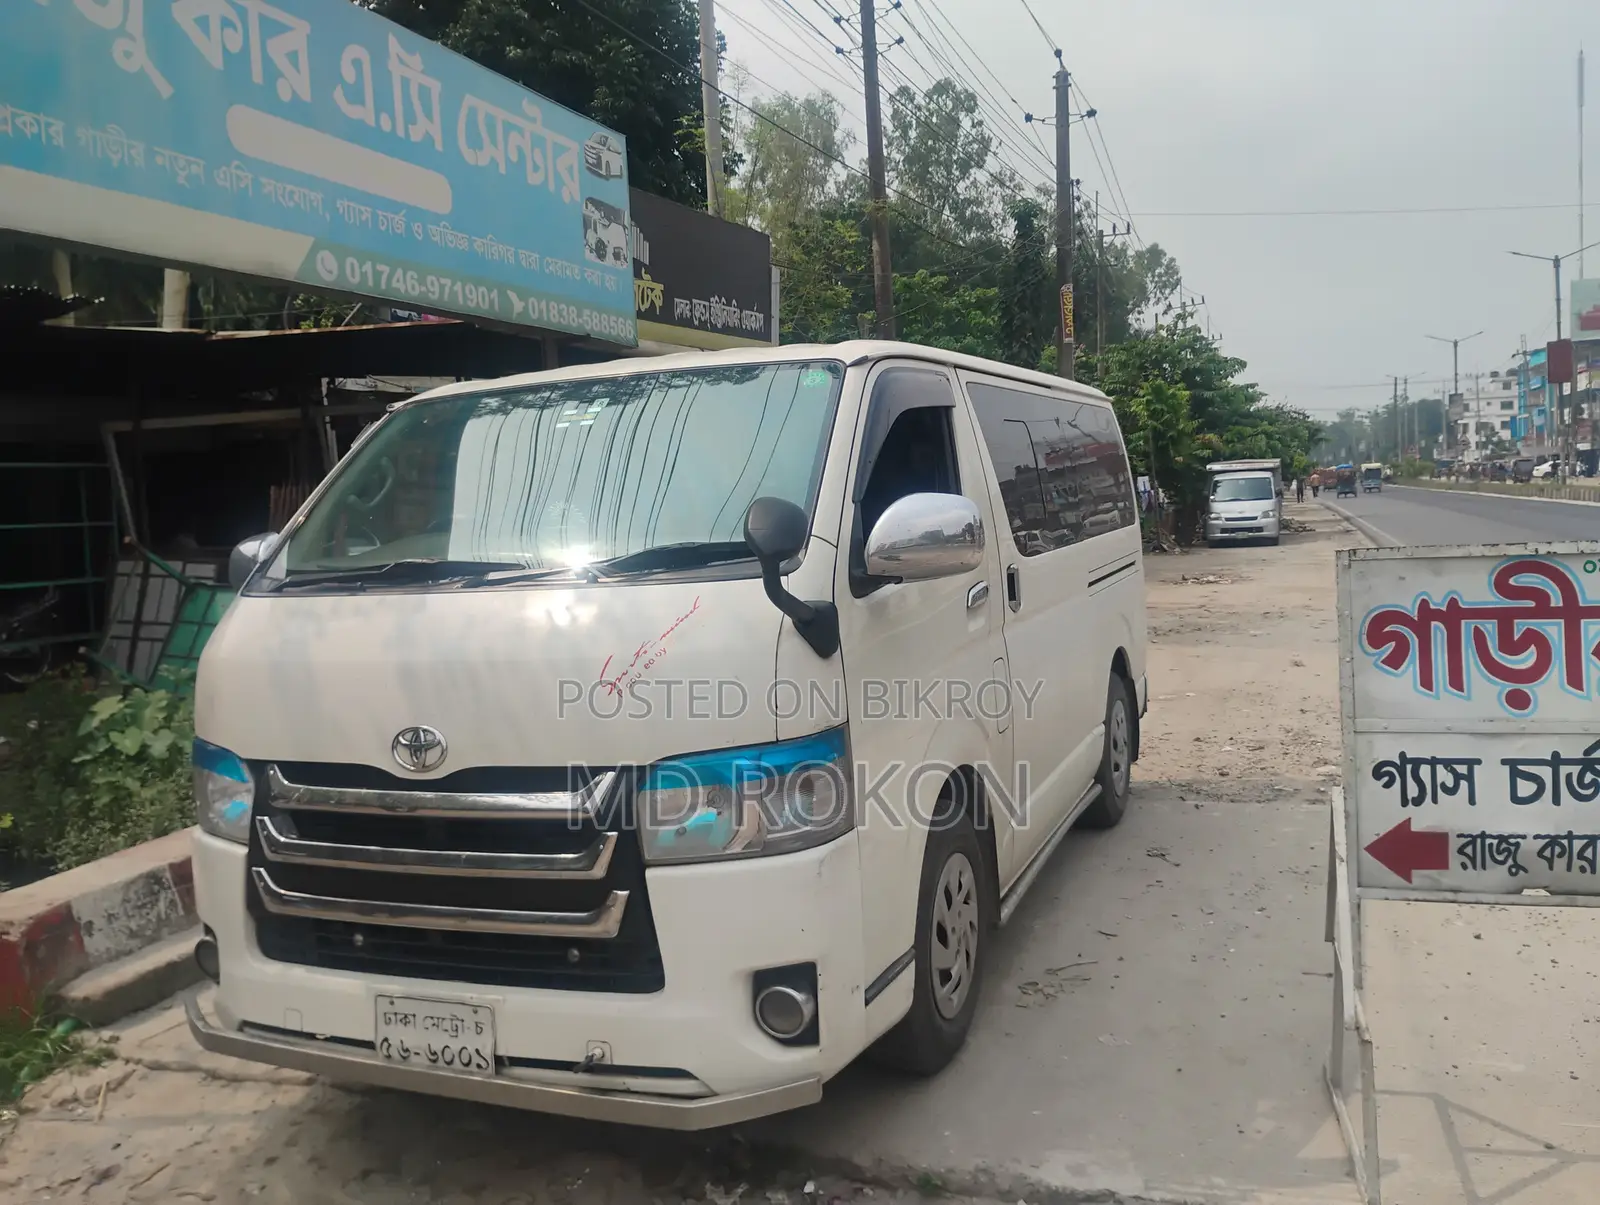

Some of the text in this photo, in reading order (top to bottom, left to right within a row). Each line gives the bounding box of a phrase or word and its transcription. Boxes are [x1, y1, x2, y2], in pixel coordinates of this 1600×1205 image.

[171, 0, 312, 103] কার
[333, 33, 442, 152] এ.সি
[457, 93, 582, 204] সেন্টার
[213, 160, 253, 197] এসি
[336, 197, 372, 230] গ্যাস
[376, 209, 407, 237] চার্জ
[411, 222, 423, 241] ও
[471, 233, 515, 265] কারিগর
[345, 256, 635, 339] 01746-971901 01838-588566
[1360, 556, 1600, 716] গাড়ী
[1371, 750, 1483, 809] গ্যাস
[1455, 830, 1600, 878] রাজু কার
[383, 1011, 416, 1028] ঢাকা
